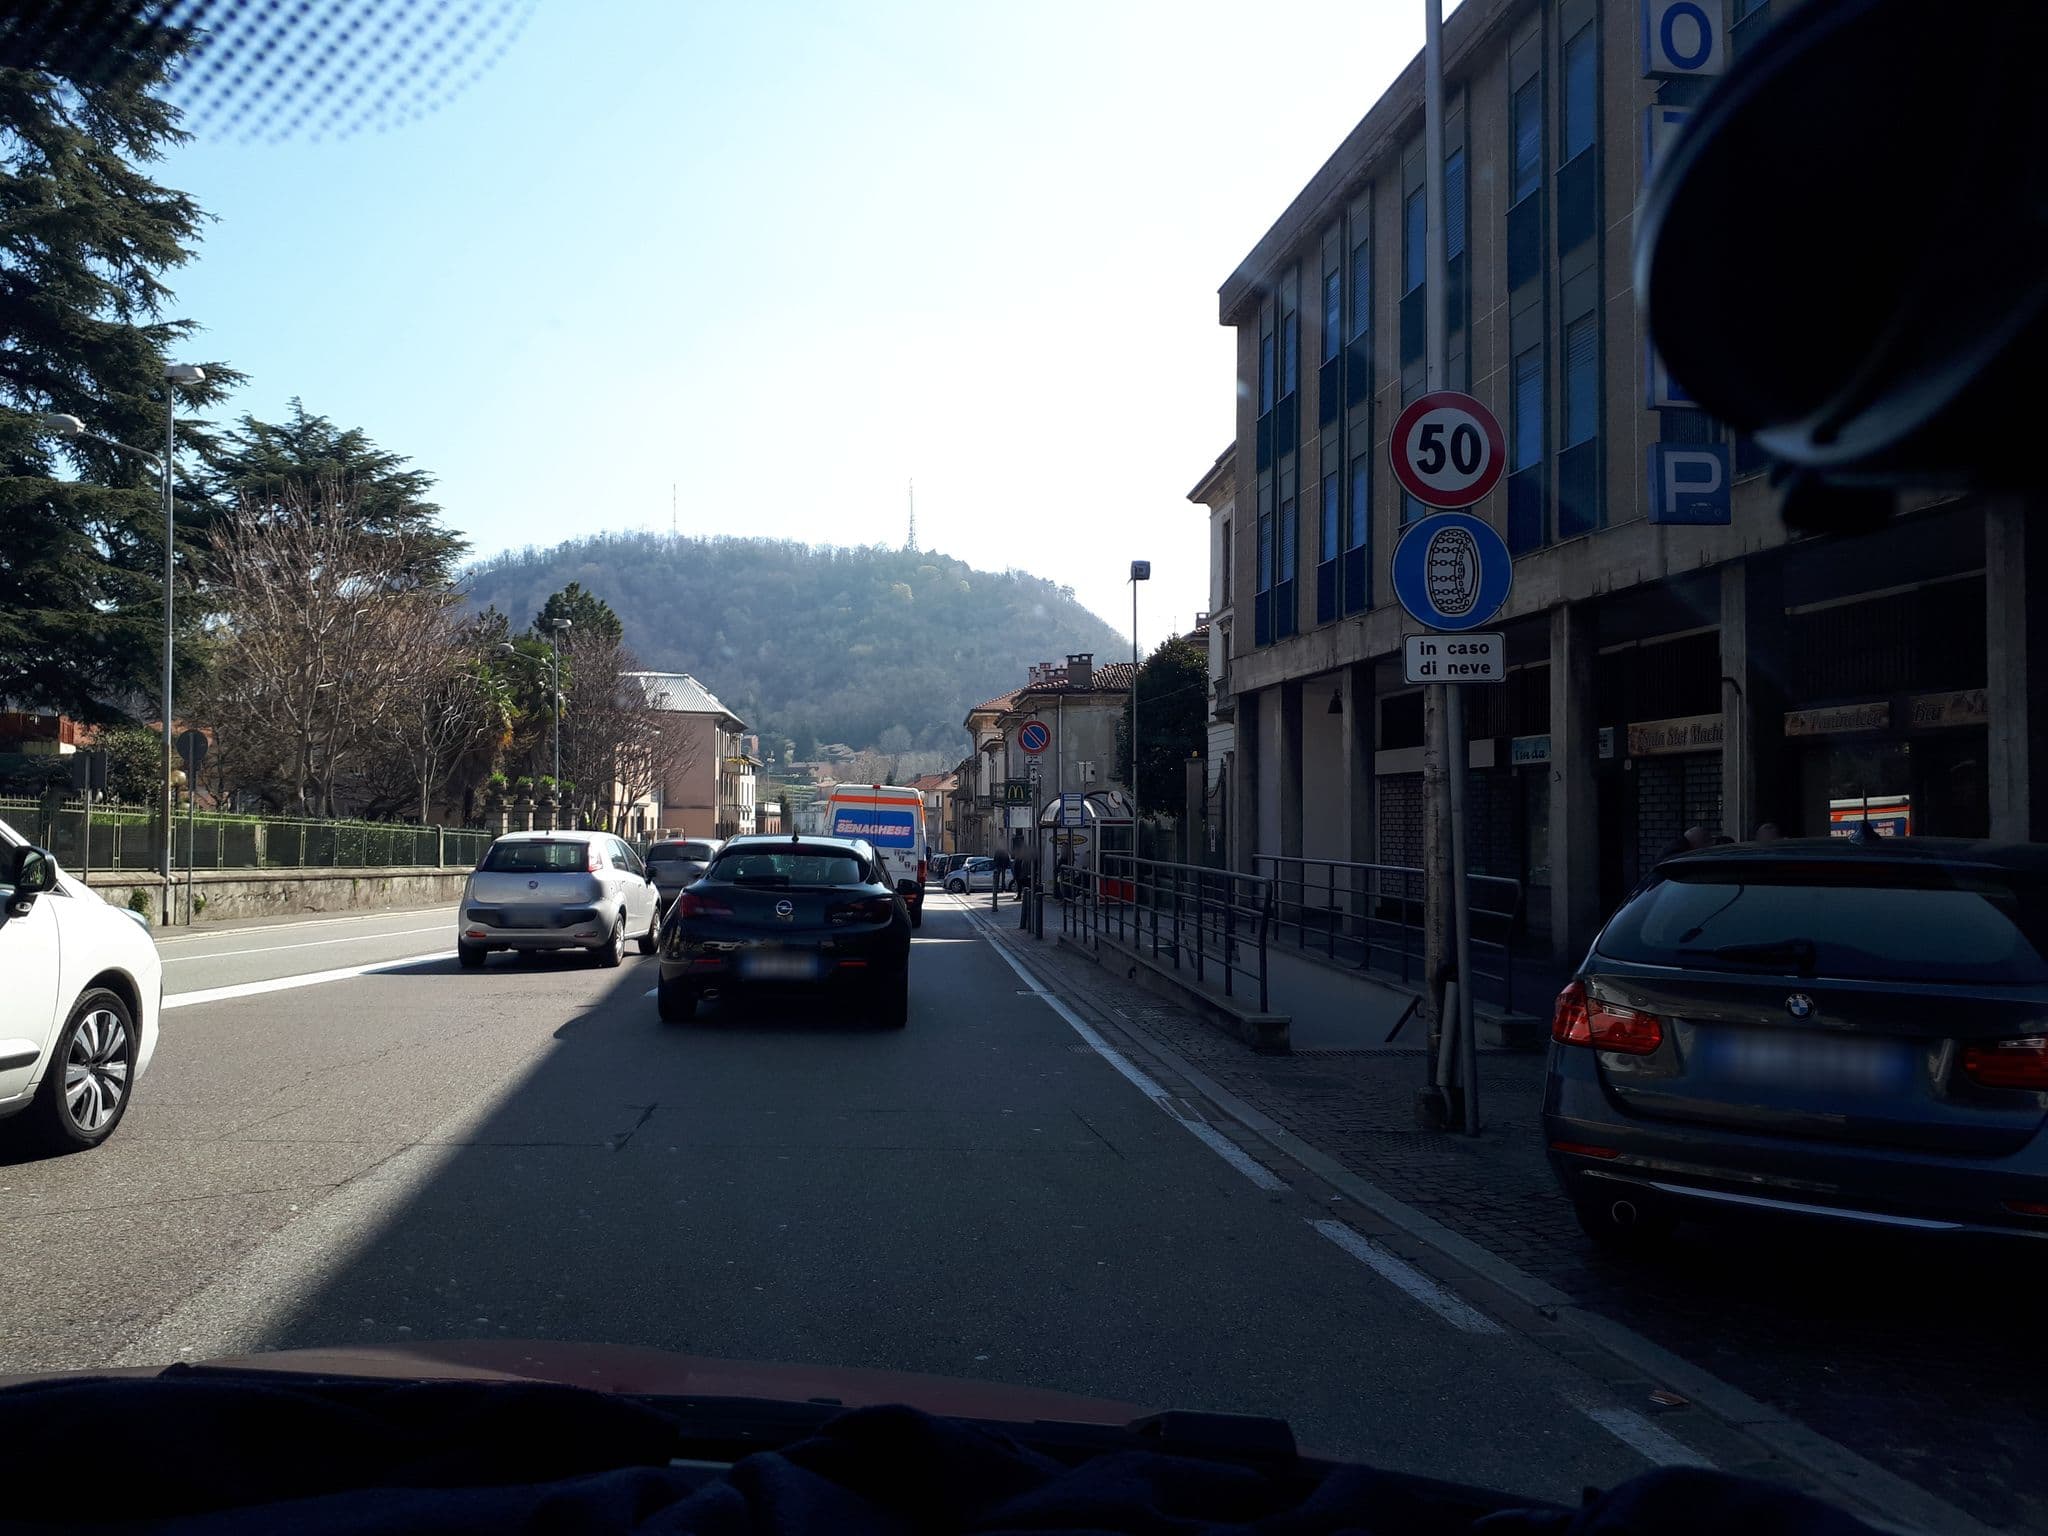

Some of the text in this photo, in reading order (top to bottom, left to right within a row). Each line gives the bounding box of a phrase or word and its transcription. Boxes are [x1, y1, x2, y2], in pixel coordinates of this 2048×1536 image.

[1661, 2, 1712, 70] O
[1416, 423, 1482, 475] 50
[1664, 451, 1721, 512] P
[1420, 641, 1490, 655] in caso
[1420, 661, 1491, 675] di neve
[836, 823, 911, 836] SENAGHESE
